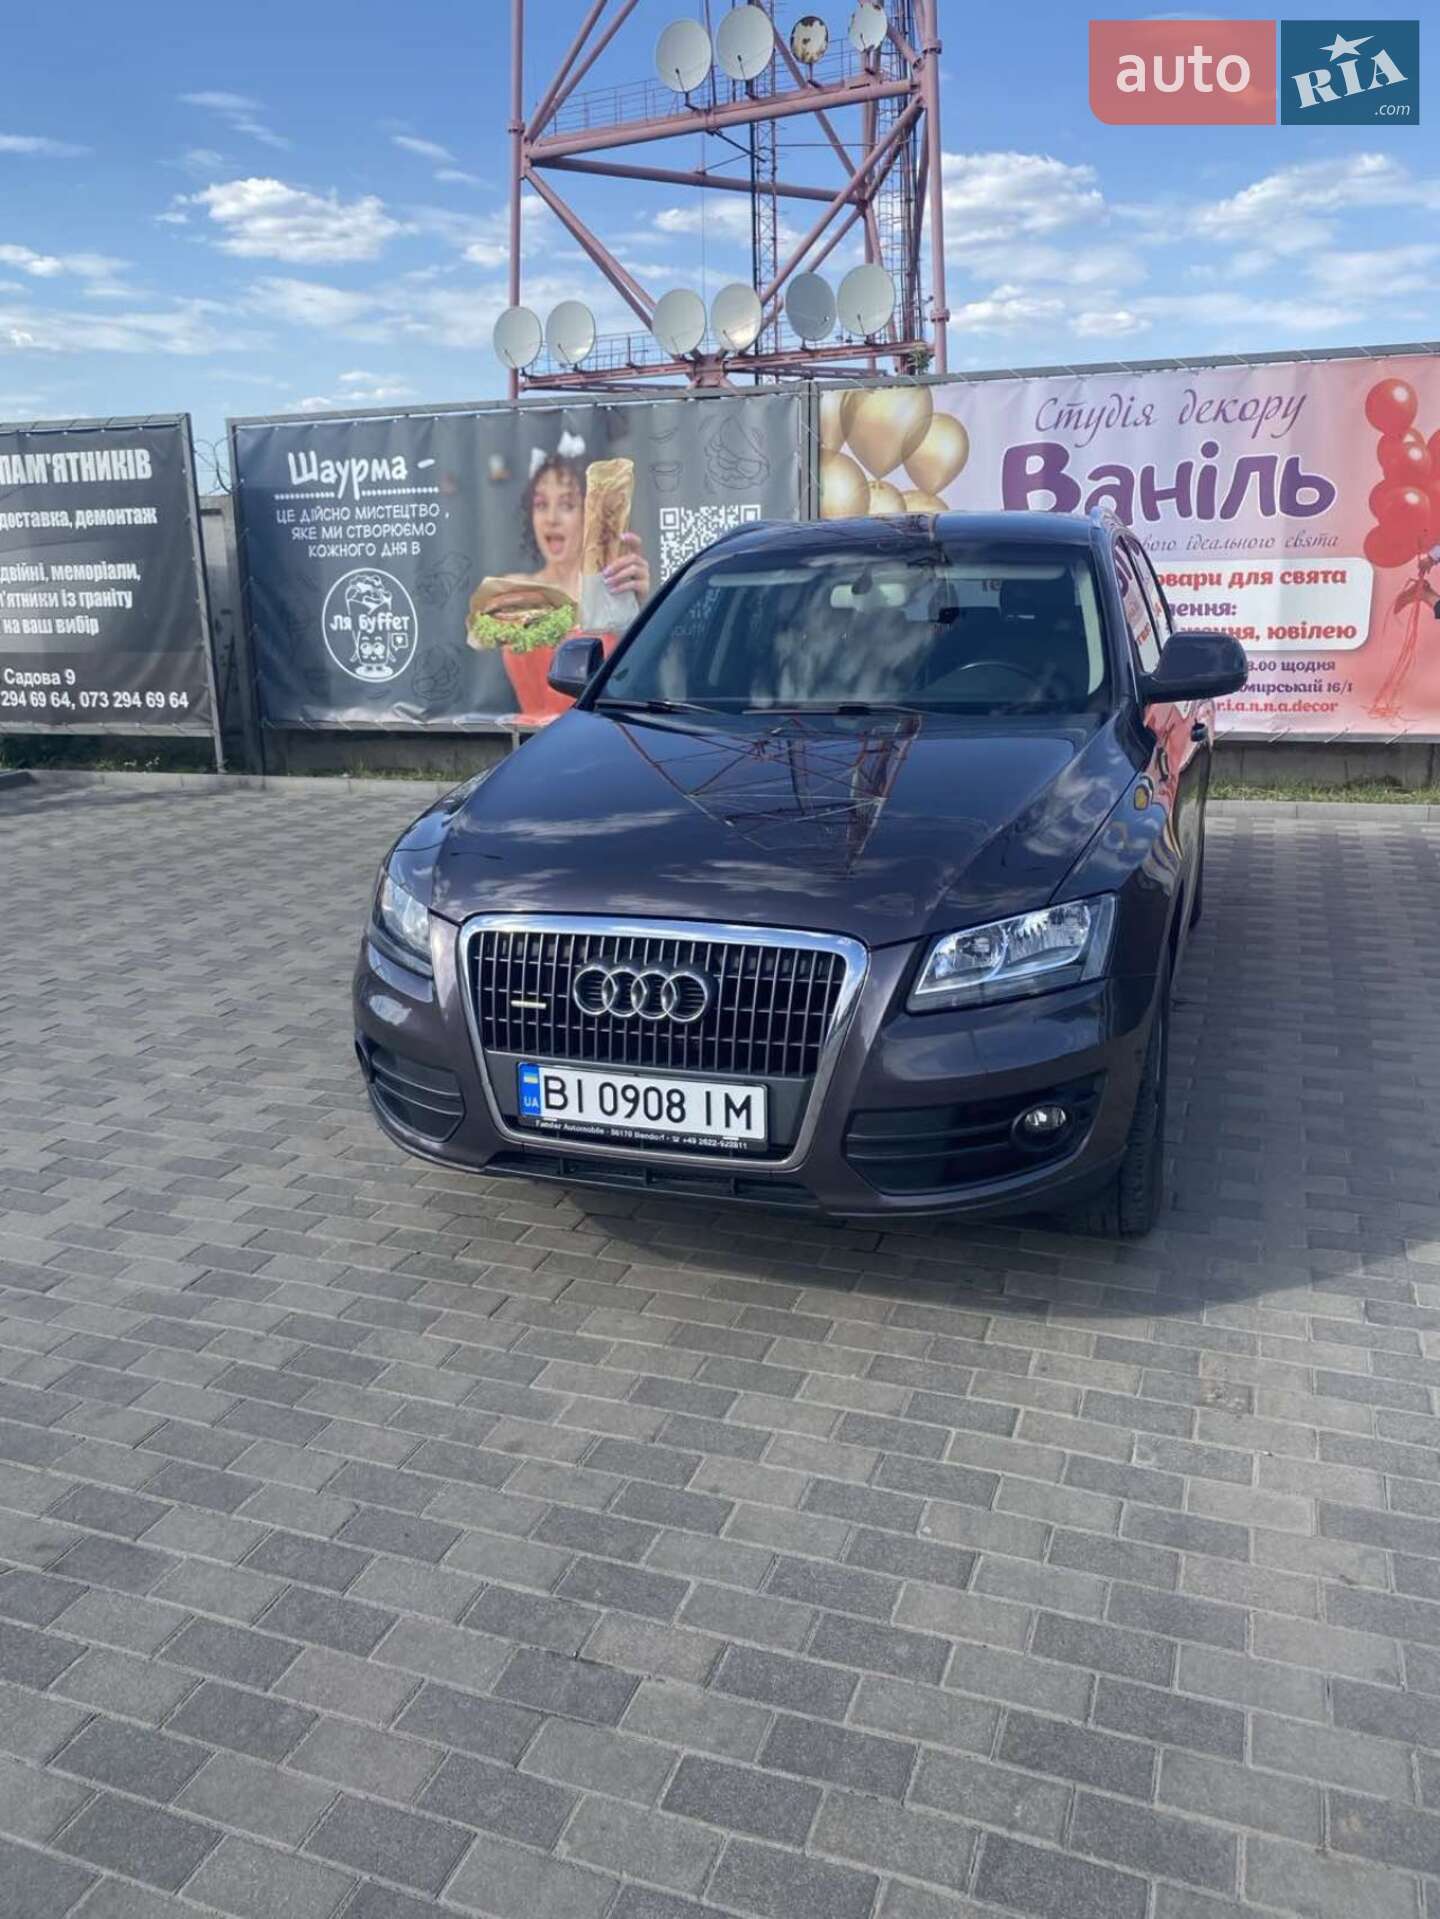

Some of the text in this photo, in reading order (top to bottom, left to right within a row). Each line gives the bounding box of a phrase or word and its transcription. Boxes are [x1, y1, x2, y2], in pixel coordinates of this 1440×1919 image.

[1035, 388, 1308, 448] Студія декору
[288, 450, 408, 500] Шаурма
[1001, 440, 1336, 526] Ваніль
[0, 507, 158, 531] доставка, демонтаж
[276, 509, 296, 524] ЦЕ
[300, 507, 351, 524] ДІЙСНО
[355, 503, 440, 521] МИСТЕЦТВО
[291, 522, 437, 540] ЯКЕ МИ СТВОРЮЄМО
[1142, 530, 1340, 551] вого ідеального свята
[308, 542, 422, 558] КОЖНОГО ДНЯ В
[0, 561, 141, 584] двійні, меморіали,
[1155, 569, 1348, 591] овари для свята
[61, 588, 77, 607] із
[79, 588, 134, 610] граніту
[3, 615, 100, 636] на ваш вибір
[329, 614, 352, 631] Ля
[1267, 620, 1357, 640] ювілею
[4, 668, 77, 687] Садова 9
[1280, 661, 1336, 673] щодня
[1239, 680, 1324, 695] омирський
[1, 690, 190, 710] 294 69 64, 073 294 69 64
[1216, 700, 1340, 713] r.i.a.n.n.a.decor
[523, 1096, 540, 1109] UA
[543, 1074, 753, 1131] BI 0908 IM
